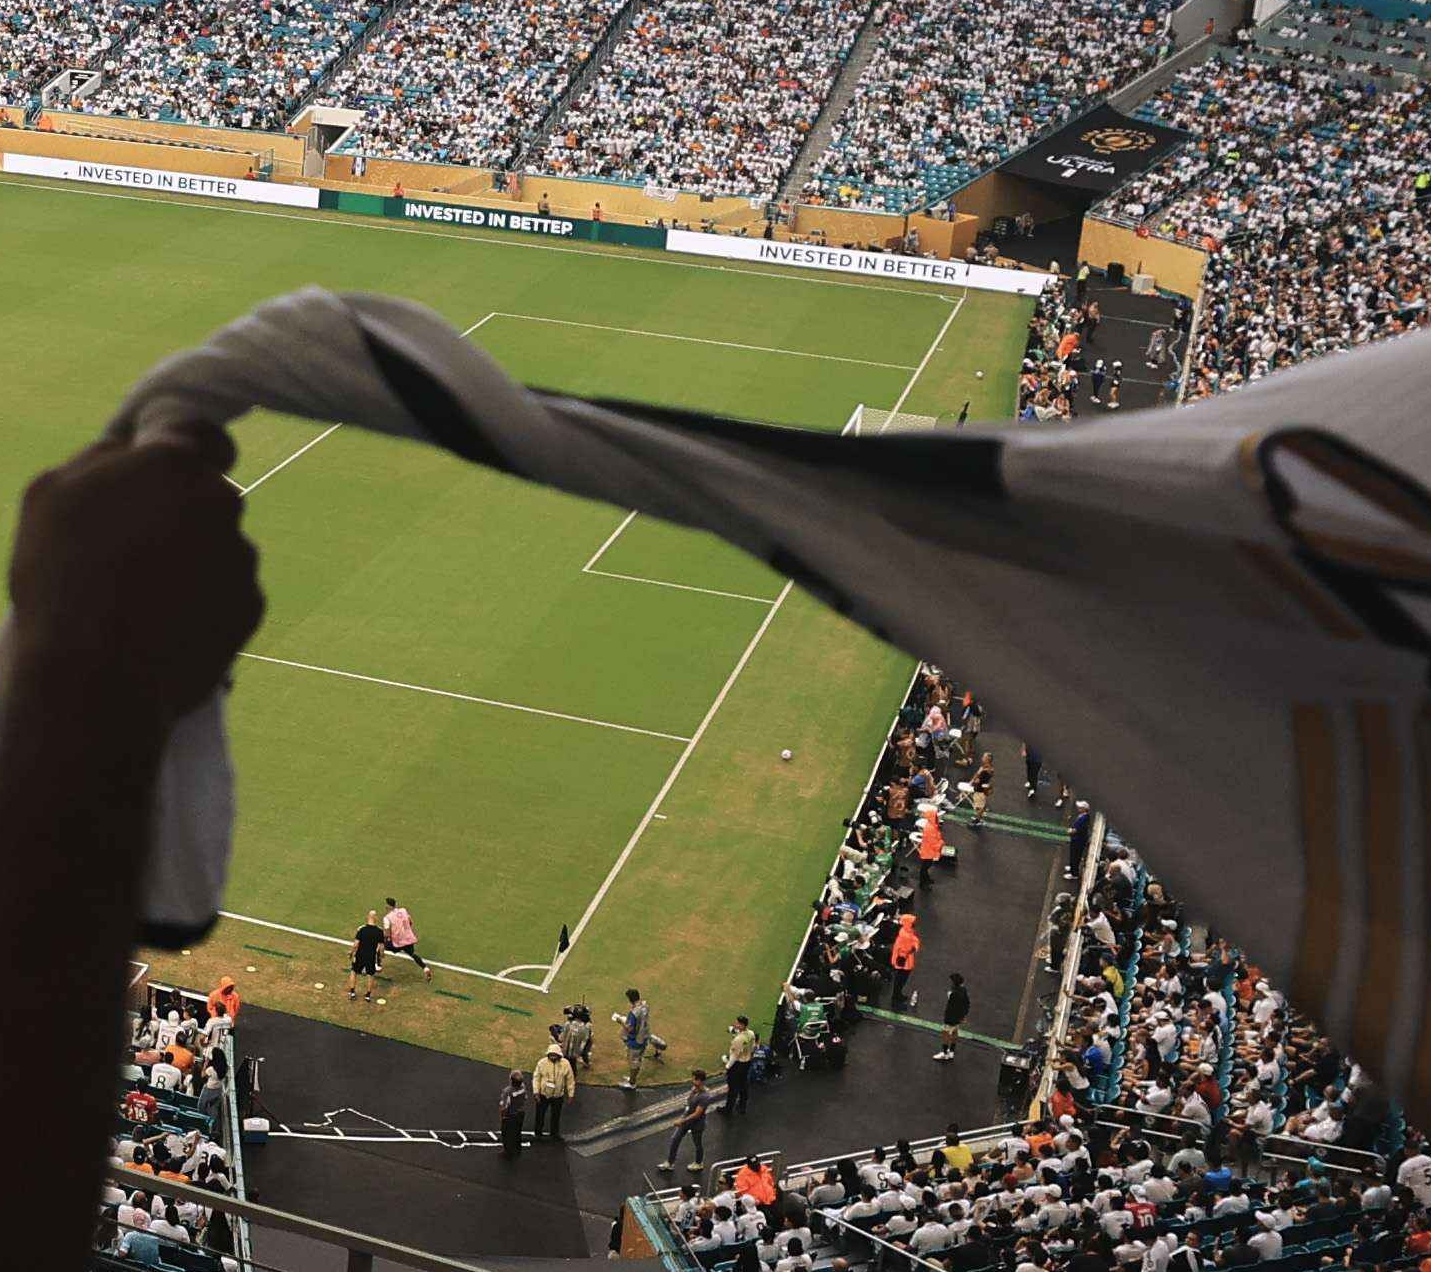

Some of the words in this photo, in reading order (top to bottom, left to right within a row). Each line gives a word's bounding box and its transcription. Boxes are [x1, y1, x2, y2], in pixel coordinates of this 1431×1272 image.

[1046, 155, 1115, 174] ULTRA
[79, 165, 152, 185] INVESTED
[158, 175, 172, 187] IN
[179, 177, 237, 195] BETTER
[405, 204, 484, 224] INVESTED
[489, 213, 506, 227] IN
[759, 245, 852, 267] INVESTED
[859, 257, 877, 270] IN
[884, 260, 956, 280] BETTER
[156, 1075, 166, 1089] 8
